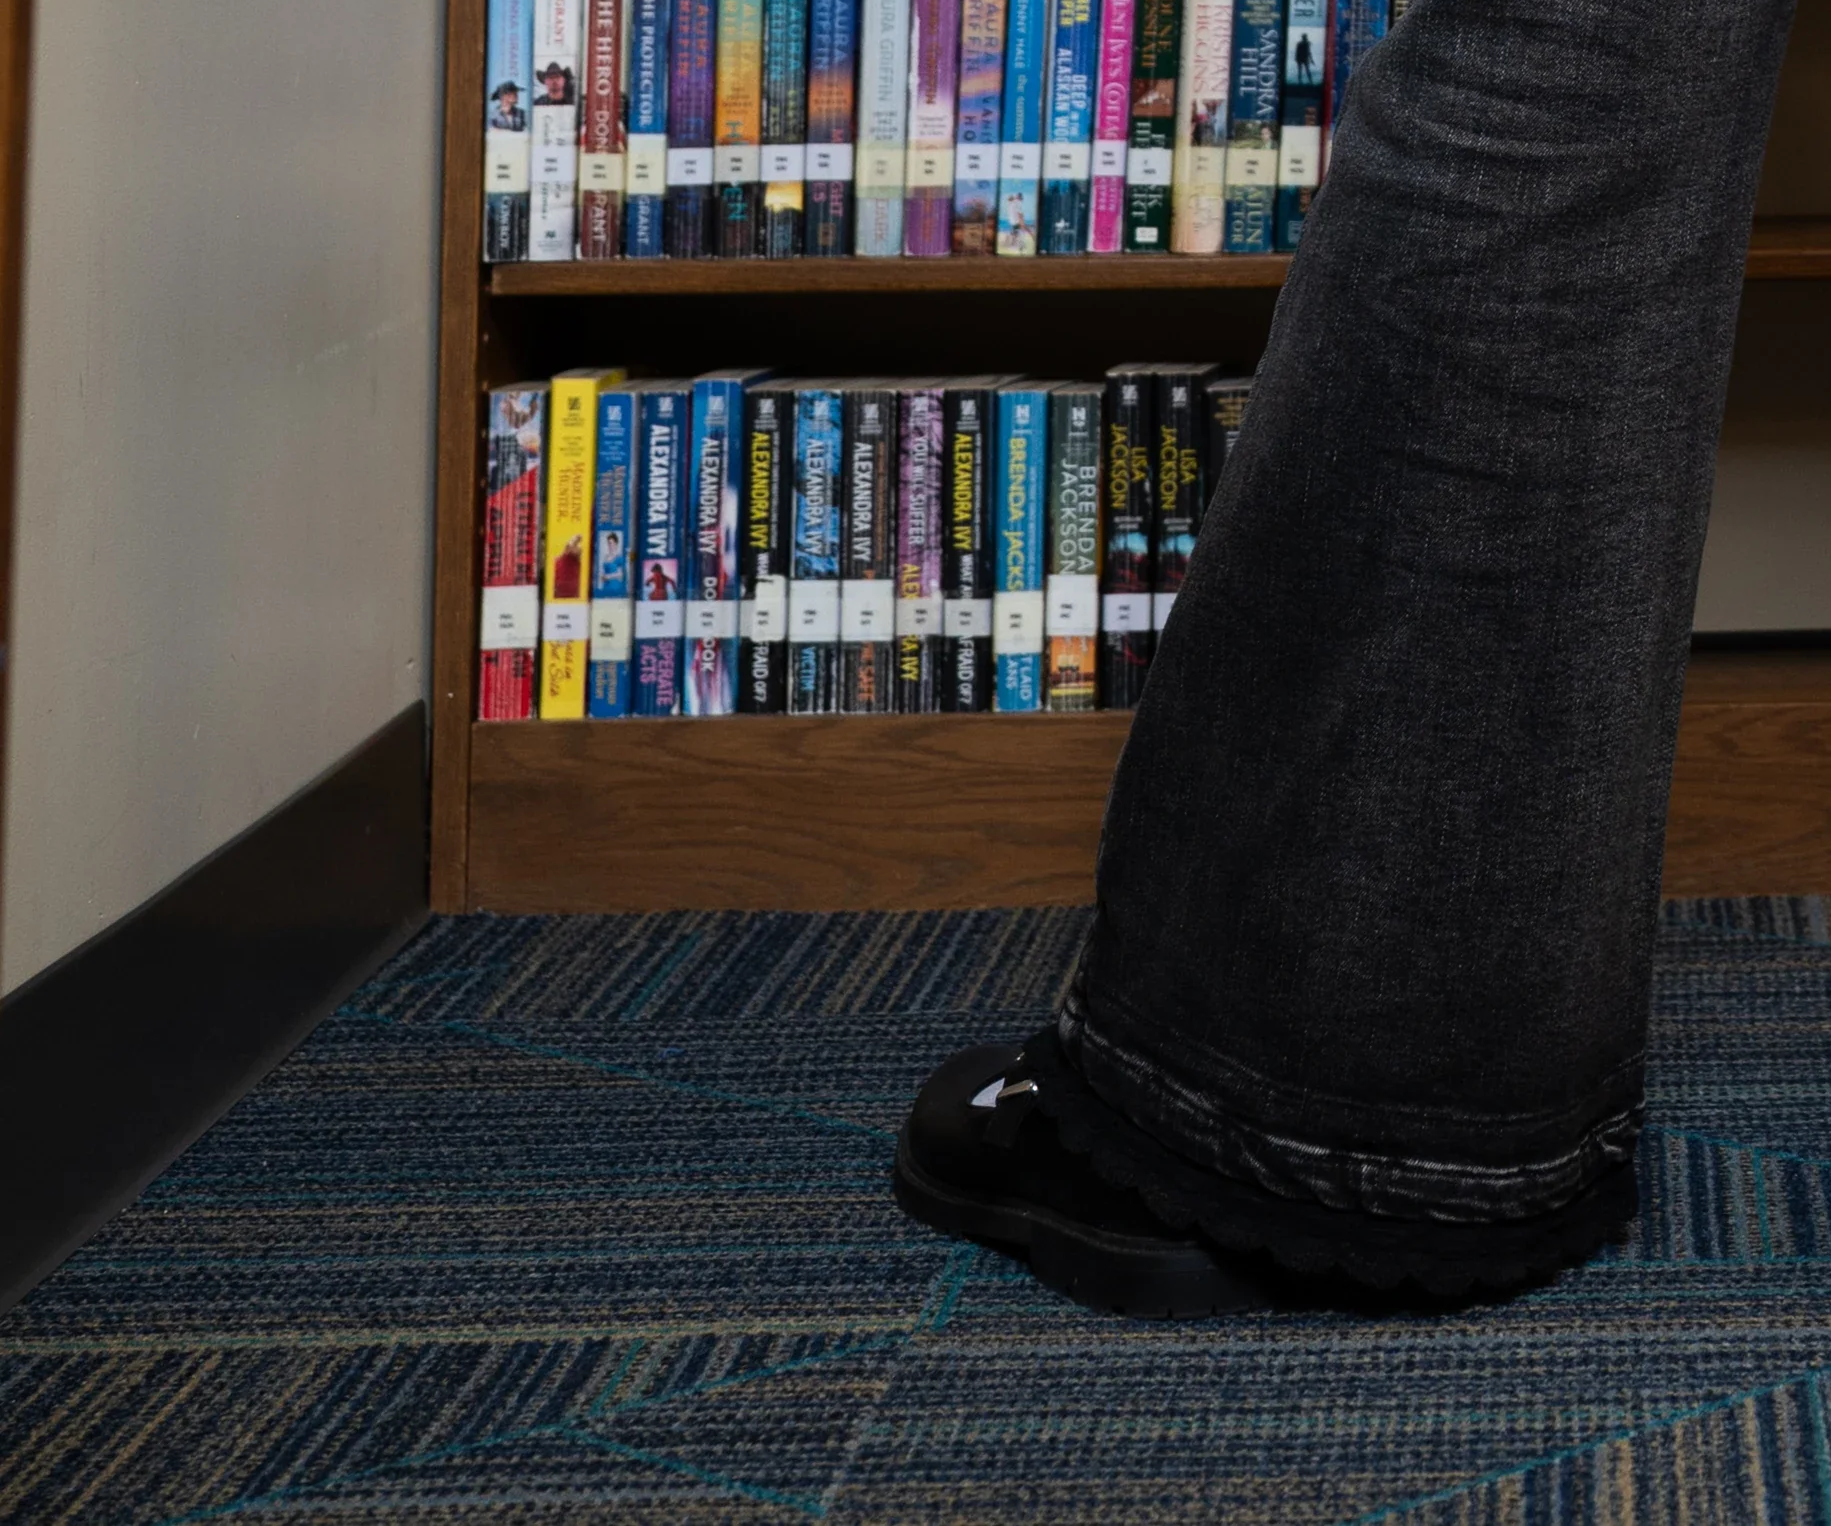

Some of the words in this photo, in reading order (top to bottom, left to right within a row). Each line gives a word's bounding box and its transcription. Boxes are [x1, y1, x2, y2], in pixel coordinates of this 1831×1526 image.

[596, 37, 612, 96] HERO
[639, 26, 656, 127] PROTECTOR
[1055, 48, 1071, 112] ALASKAN
[1239, 47, 1259, 97] HILL
[1258, 28, 1277, 116] SANDRA
[648, 424, 668, 523] ALEXANDRA
[750, 432, 770, 519] ALEXANDRA
[910, 465, 925, 489] WILL
[911, 436, 927, 462] YOU
[953, 433, 972, 520] ALEXANDRA
[1111, 423, 1129, 509] JACKSON
[1131, 446, 1148, 482] LISA
[1159, 425, 1178, 510] JACKSON
[1180, 448, 1197, 485] LISA
[699, 438, 718, 526] ALEXANDRA
[805, 439, 822, 526] ALEXANDRA
[853, 442, 872, 533] ALEXANDRA
[1007, 437, 1026, 522] BRENDA
[647, 527, 668, 557] IVY
[698, 529, 717, 555] IVY
[749, 523, 769, 549] IVY
[805, 530, 821, 555] IVY
[908, 494, 924, 546] SUFFER
[953, 524, 971, 550] IVY
[1060, 457, 1077, 574] JACKSON
[1079, 465, 1096, 571] BRENDA
[853, 536, 872, 561] IVY
[640, 645, 657, 685] ACTS
[800, 646, 815, 691] VICTIM
